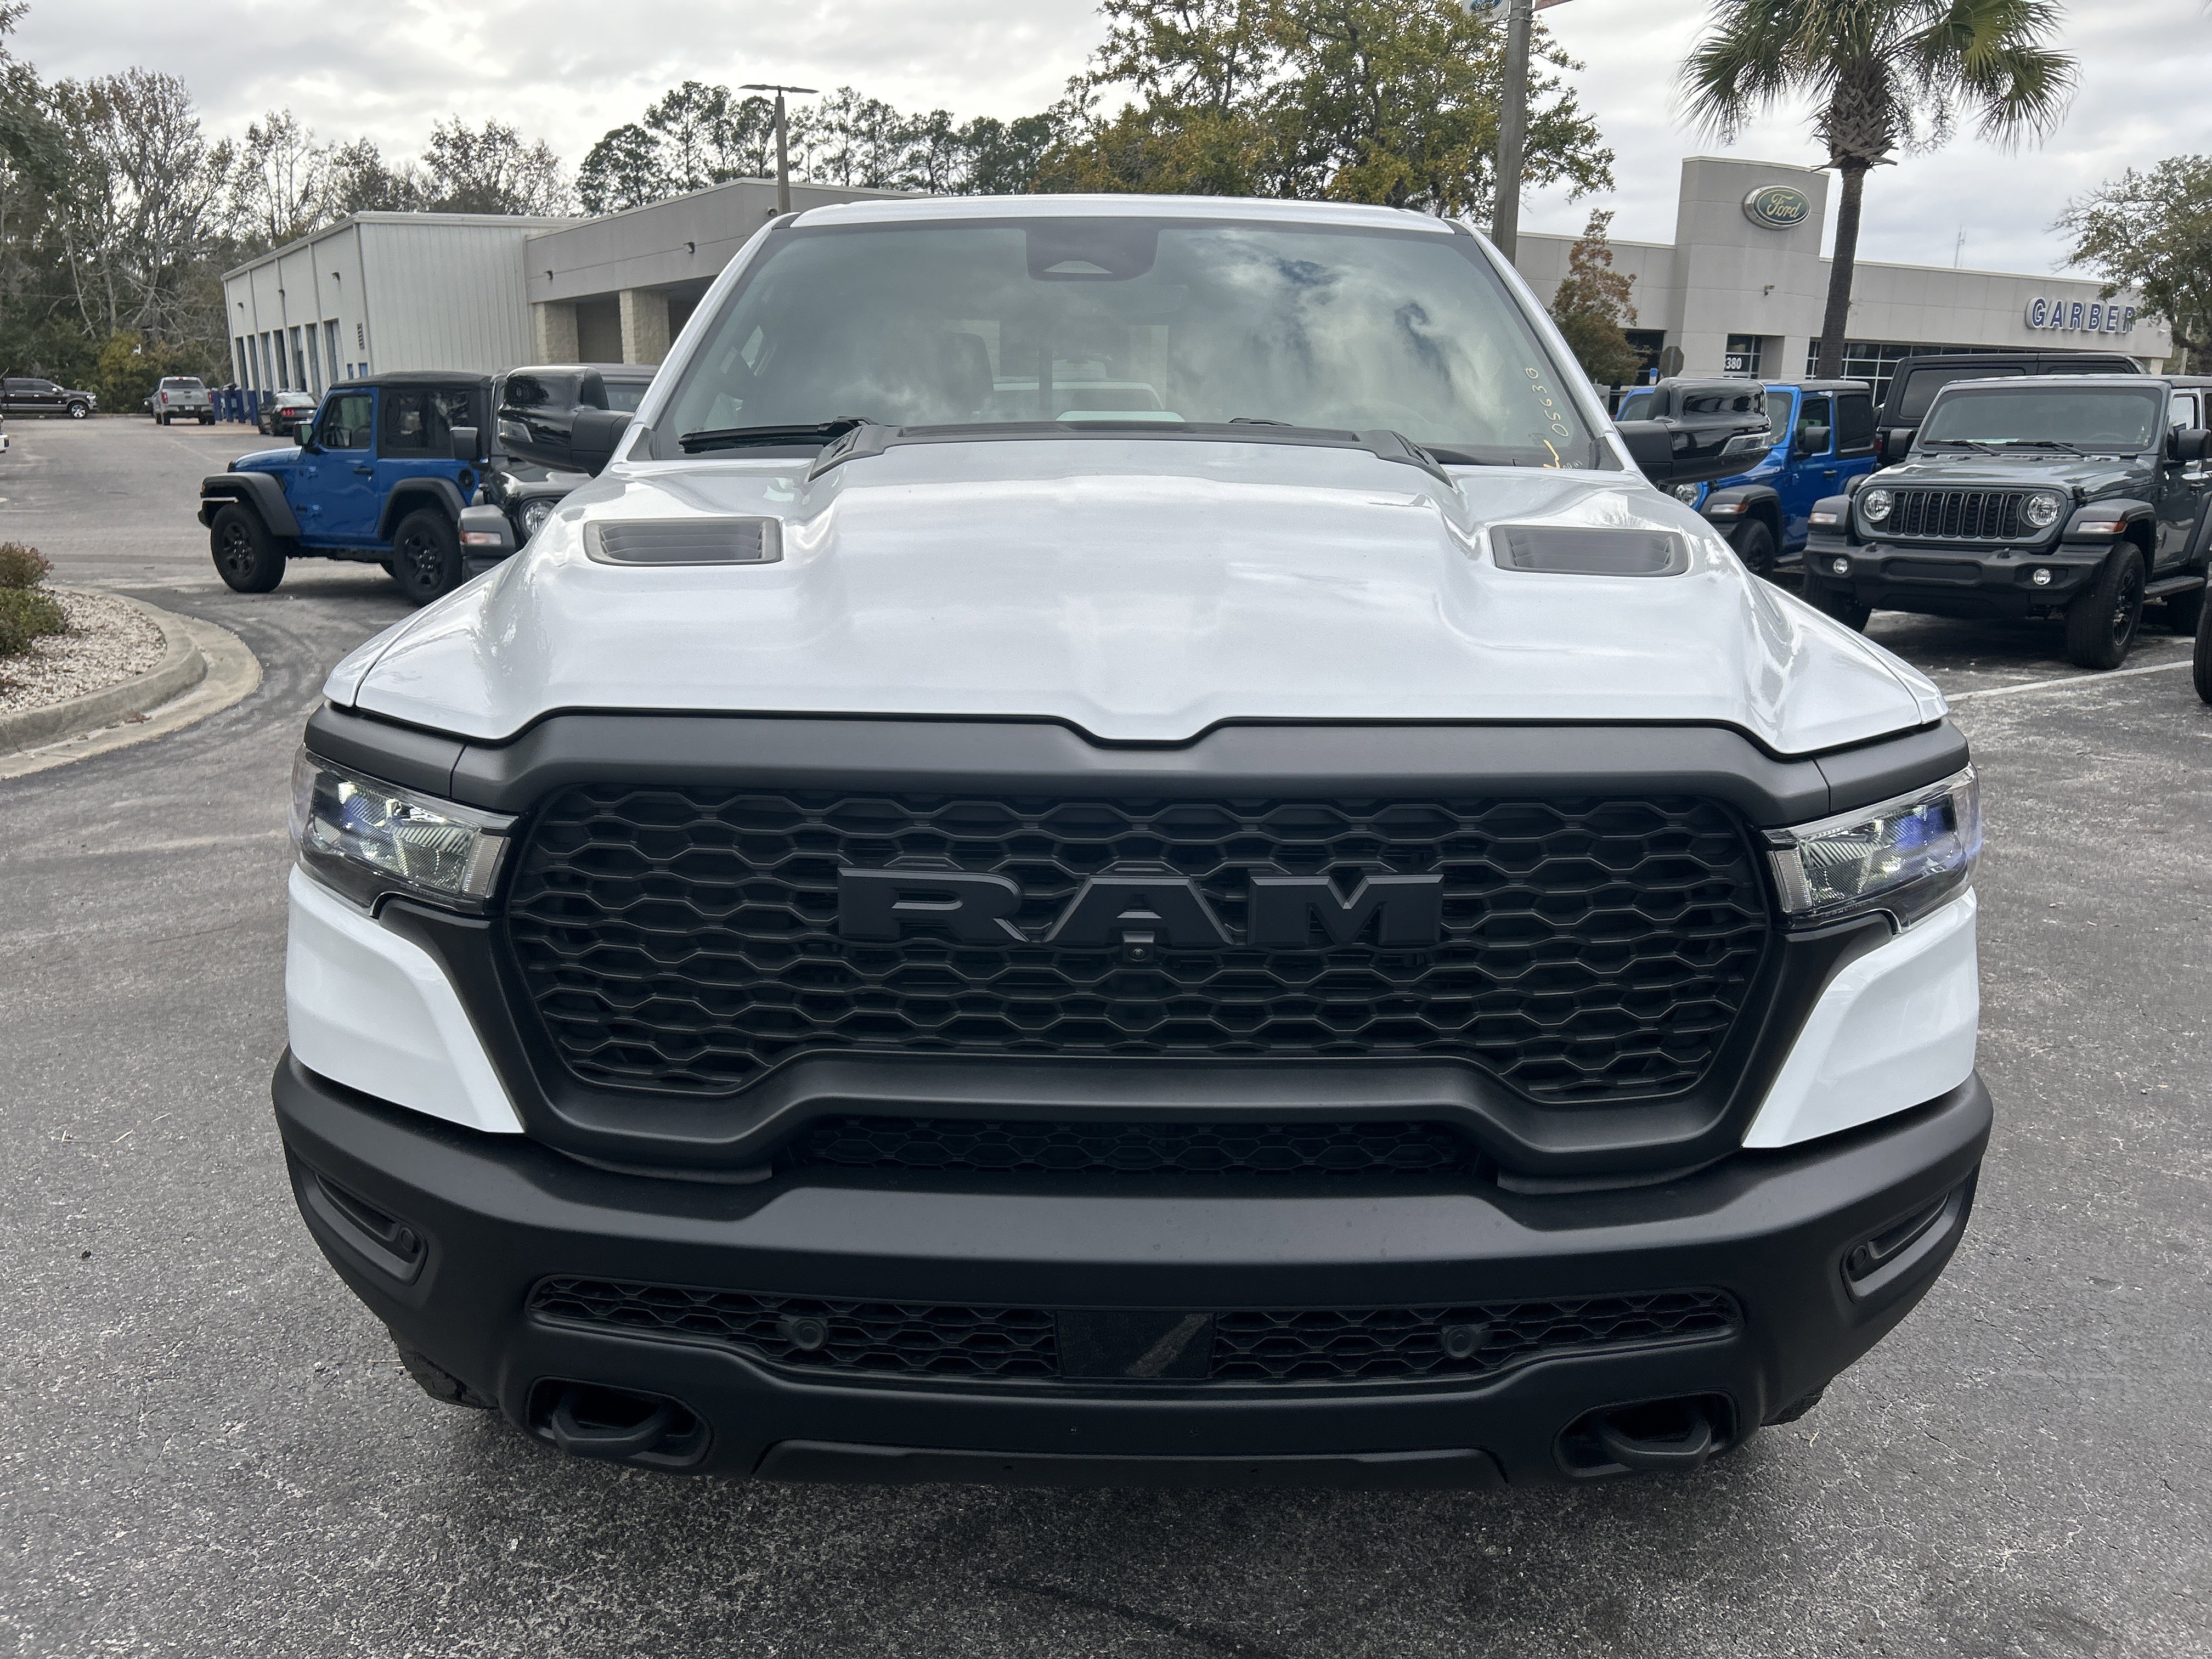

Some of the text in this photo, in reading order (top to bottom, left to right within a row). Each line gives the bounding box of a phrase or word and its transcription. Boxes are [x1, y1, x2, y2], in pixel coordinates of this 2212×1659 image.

[1766, 193, 1802, 218] Ford
[2030, 297, 2136, 334] GARBER
[837, 866, 1444, 945] RAM
